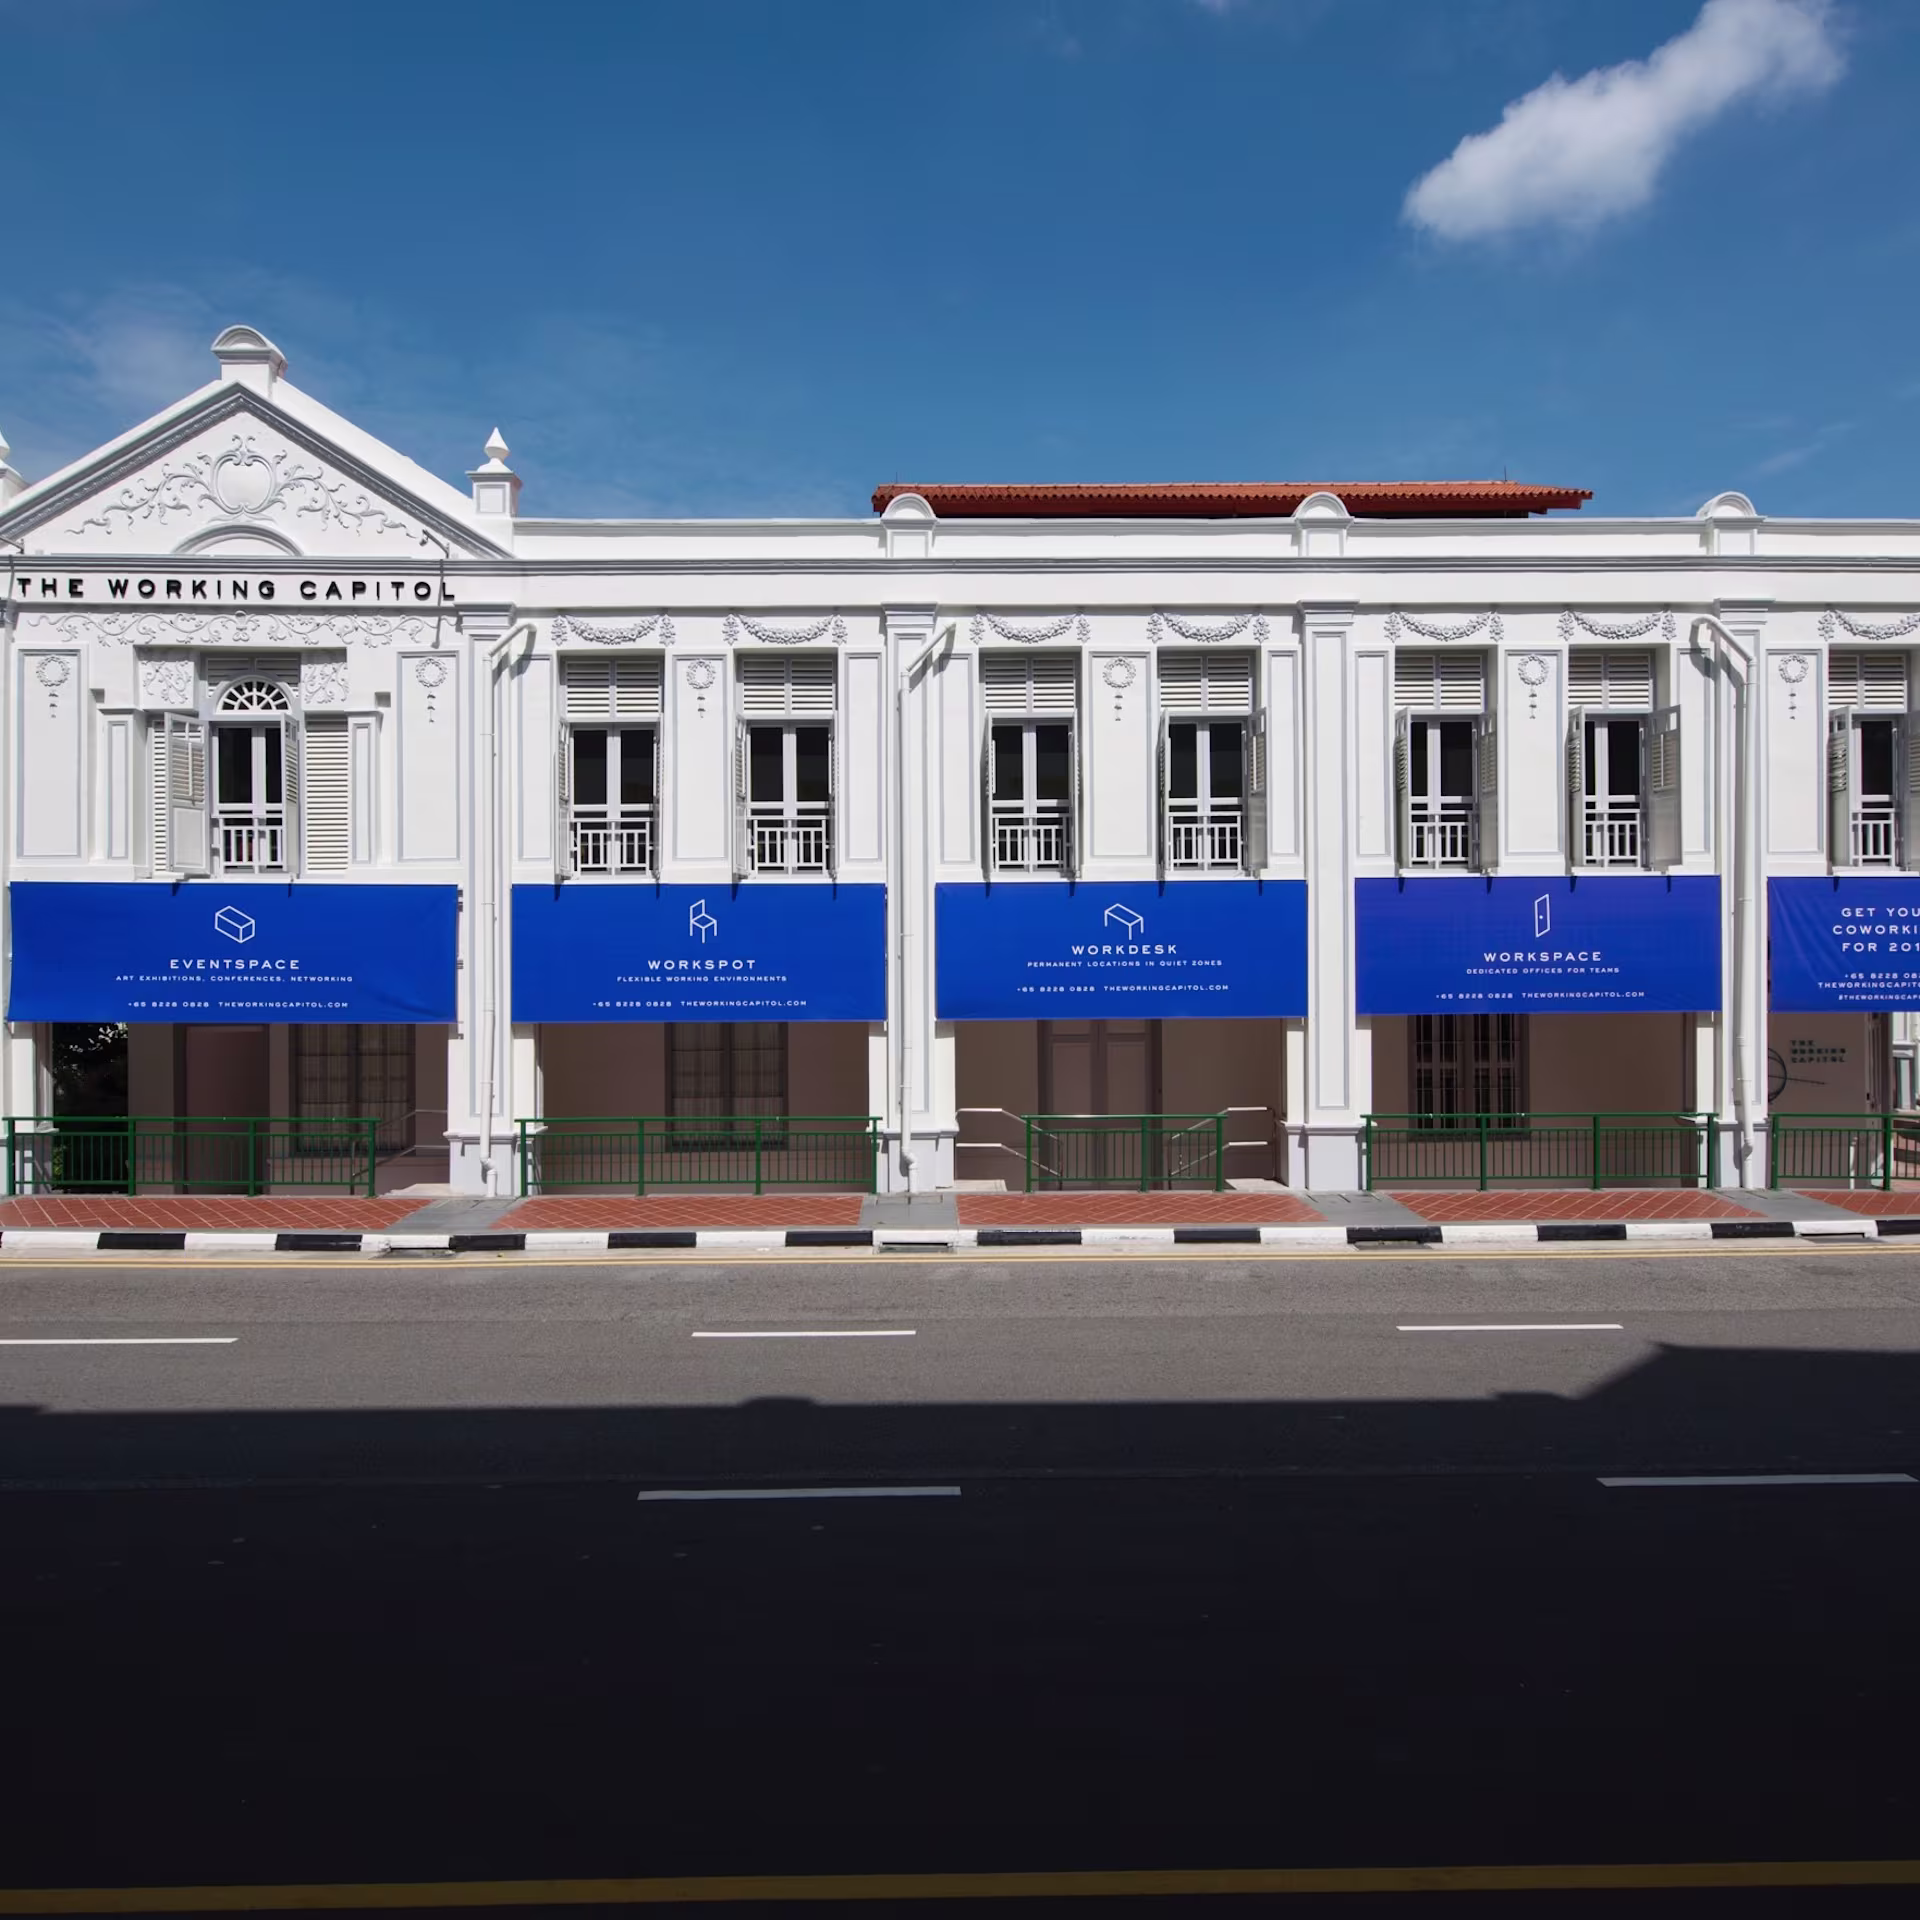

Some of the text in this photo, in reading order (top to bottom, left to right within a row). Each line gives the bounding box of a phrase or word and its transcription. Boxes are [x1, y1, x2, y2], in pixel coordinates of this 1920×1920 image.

[16, 577, 456, 601] THE WORKING CAPITOL
[1841, 907, 1876, 918] GET
[1071, 944, 1177, 956] WORKDESK
[1841, 942, 1878, 953] FOR
[1483, 951, 1602, 963] WORKSPACE
[169, 958, 300, 970] EVENTSPACE
[647, 959, 756, 971] WORKSPOT
[1087, 960, 1141, 968] LOCATIONS
[1466, 967, 1518, 975] DEDICATED
[665, 975, 709, 983] WORKING
[1903, 972, 1920, 980] 08
[1103, 984, 1229, 992] THEWORKINGCAPITOL.COM
[1521, 991, 1645, 999] THEWORKINGCAPITOL.COM
[218, 1001, 348, 1009] THEWORKINGCAPITOL.COM
